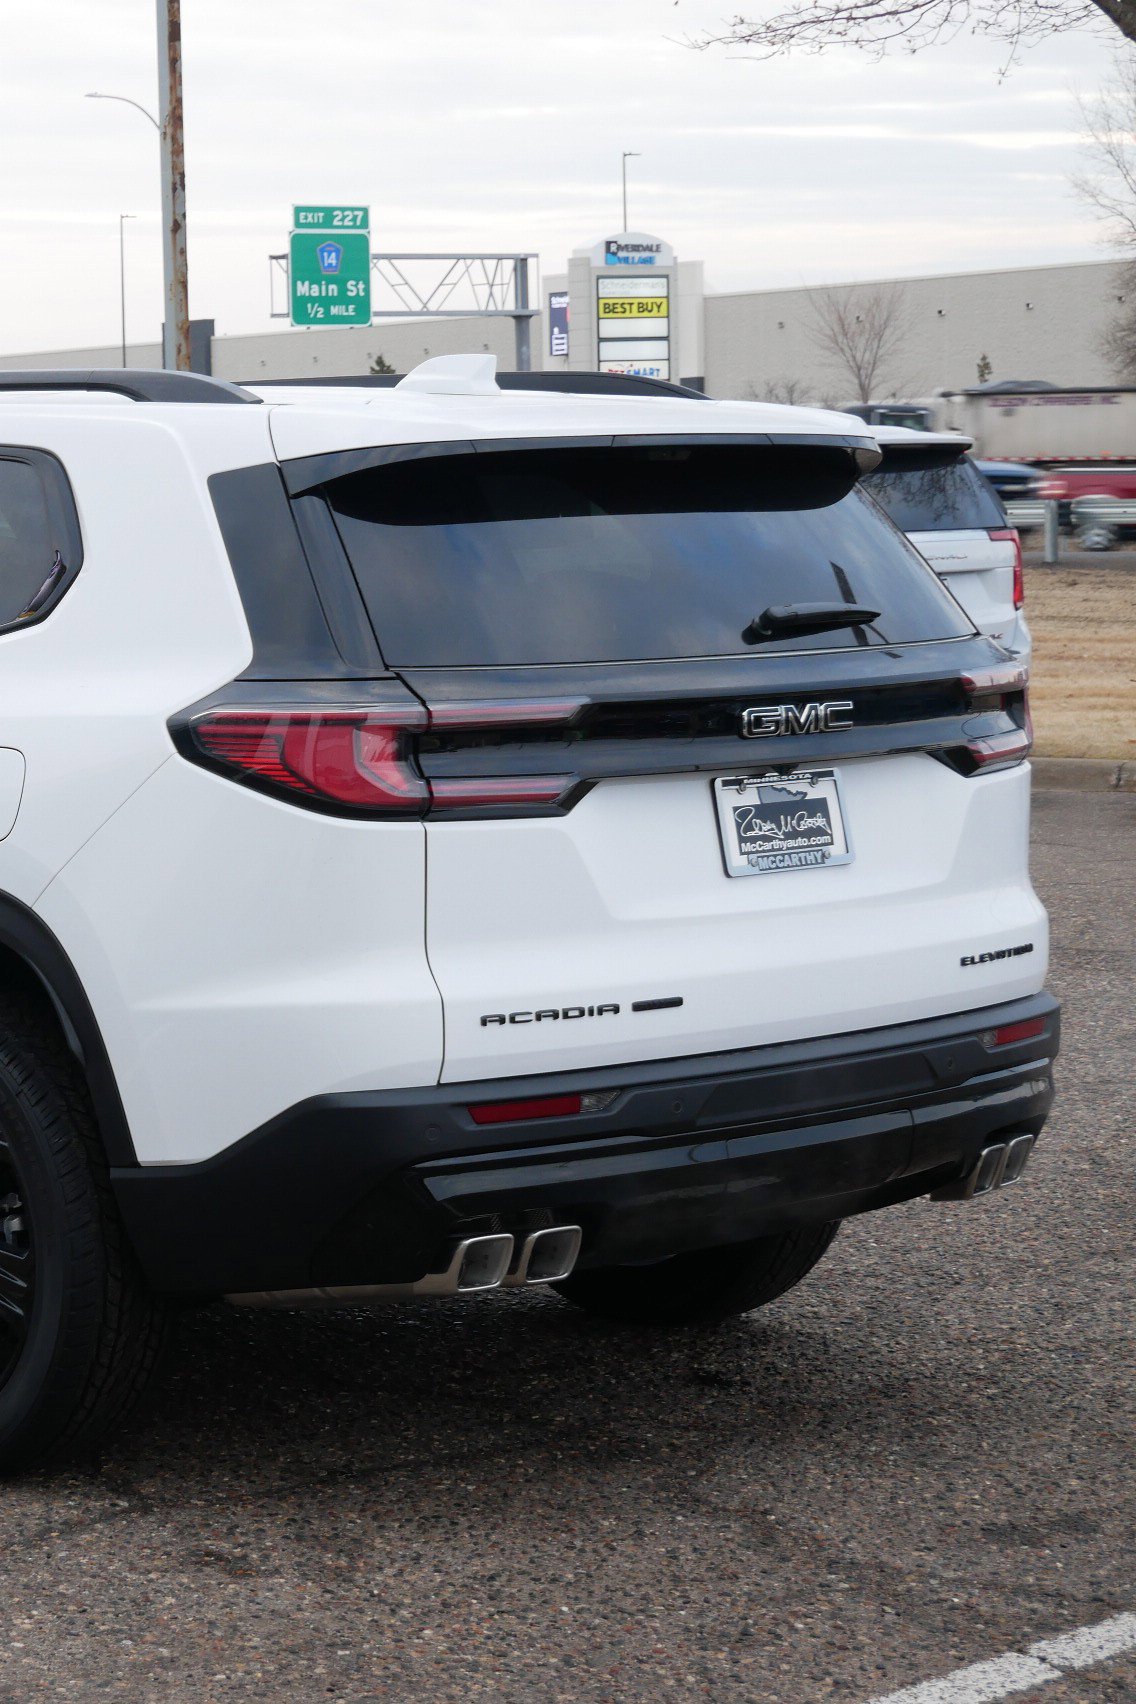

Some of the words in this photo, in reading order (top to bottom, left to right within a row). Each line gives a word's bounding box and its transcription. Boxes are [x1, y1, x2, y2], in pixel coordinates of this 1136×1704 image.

[299, 212, 324, 223] EXIT
[332, 210, 364, 226] 227
[323, 251, 338, 267] 14
[617, 256, 656, 266] VILLAGE
[296, 280, 339, 297] Main
[346, 280, 366, 297] St
[330, 305, 356, 316] MILE
[603, 302, 634, 315] BEST
[637, 301, 664, 314] BUY
[742, 701, 854, 739] GMC
[744, 773, 813, 784] MINNESOTA
[741, 835, 832, 853] McCarthyauto.com
[758, 851, 824, 870] MCCARTHY
[960, 943, 1034, 967] ELEVATION
[480, 1002, 621, 1027] ACADIA
